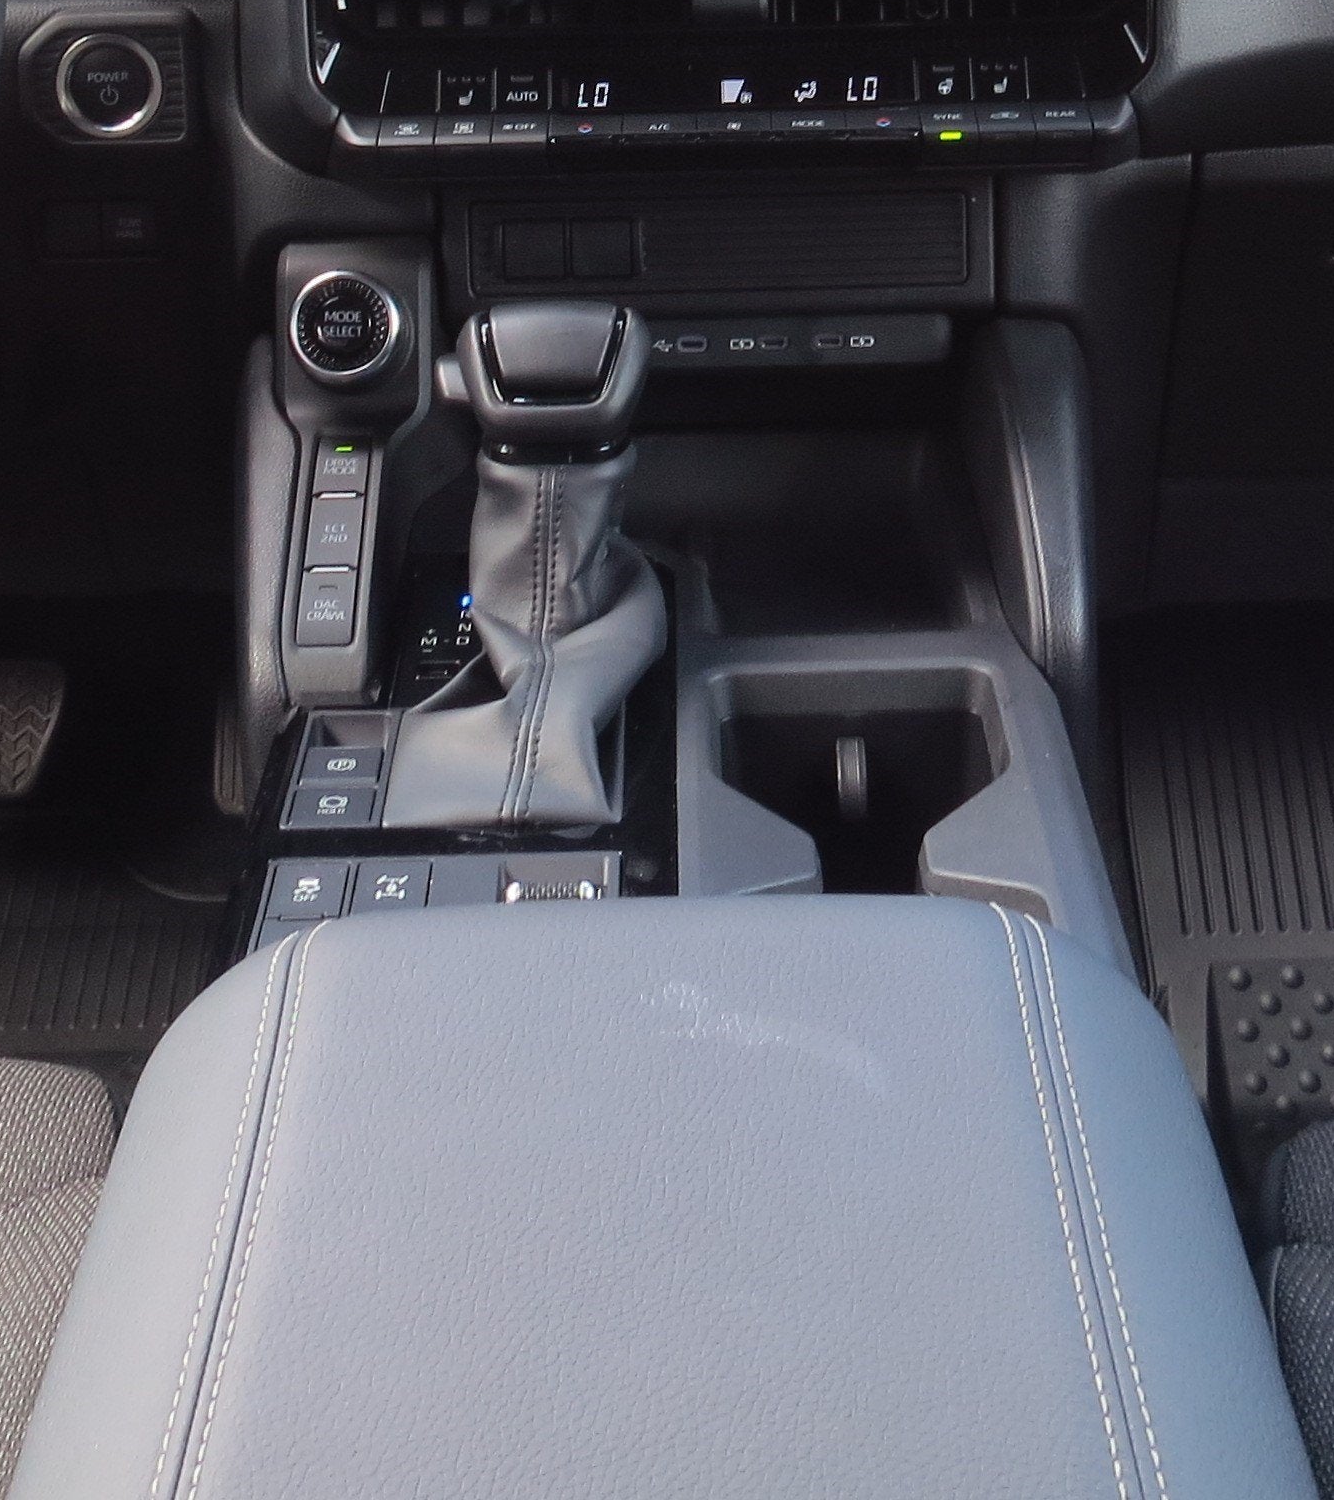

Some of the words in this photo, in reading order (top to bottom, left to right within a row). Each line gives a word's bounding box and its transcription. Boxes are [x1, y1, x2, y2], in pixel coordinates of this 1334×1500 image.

[87, 71, 129, 83] POWER
[846, 76, 878, 102] LO
[506, 90, 539, 102] AUTO
[577, 82, 609, 107] LO
[1045, 110, 1076, 118] REAR
[648, 123, 670, 132] A/C
[791, 119, 825, 128] MODE
[324, 311, 362, 322] MODE
[323, 326, 363, 338] SELECT
[323, 467, 355, 475] MODE
[320, 533, 348, 544] 2ND
[458, 623, 472, 633] N
[420, 636, 438, 646] M
[456, 636, 470, 646] D
